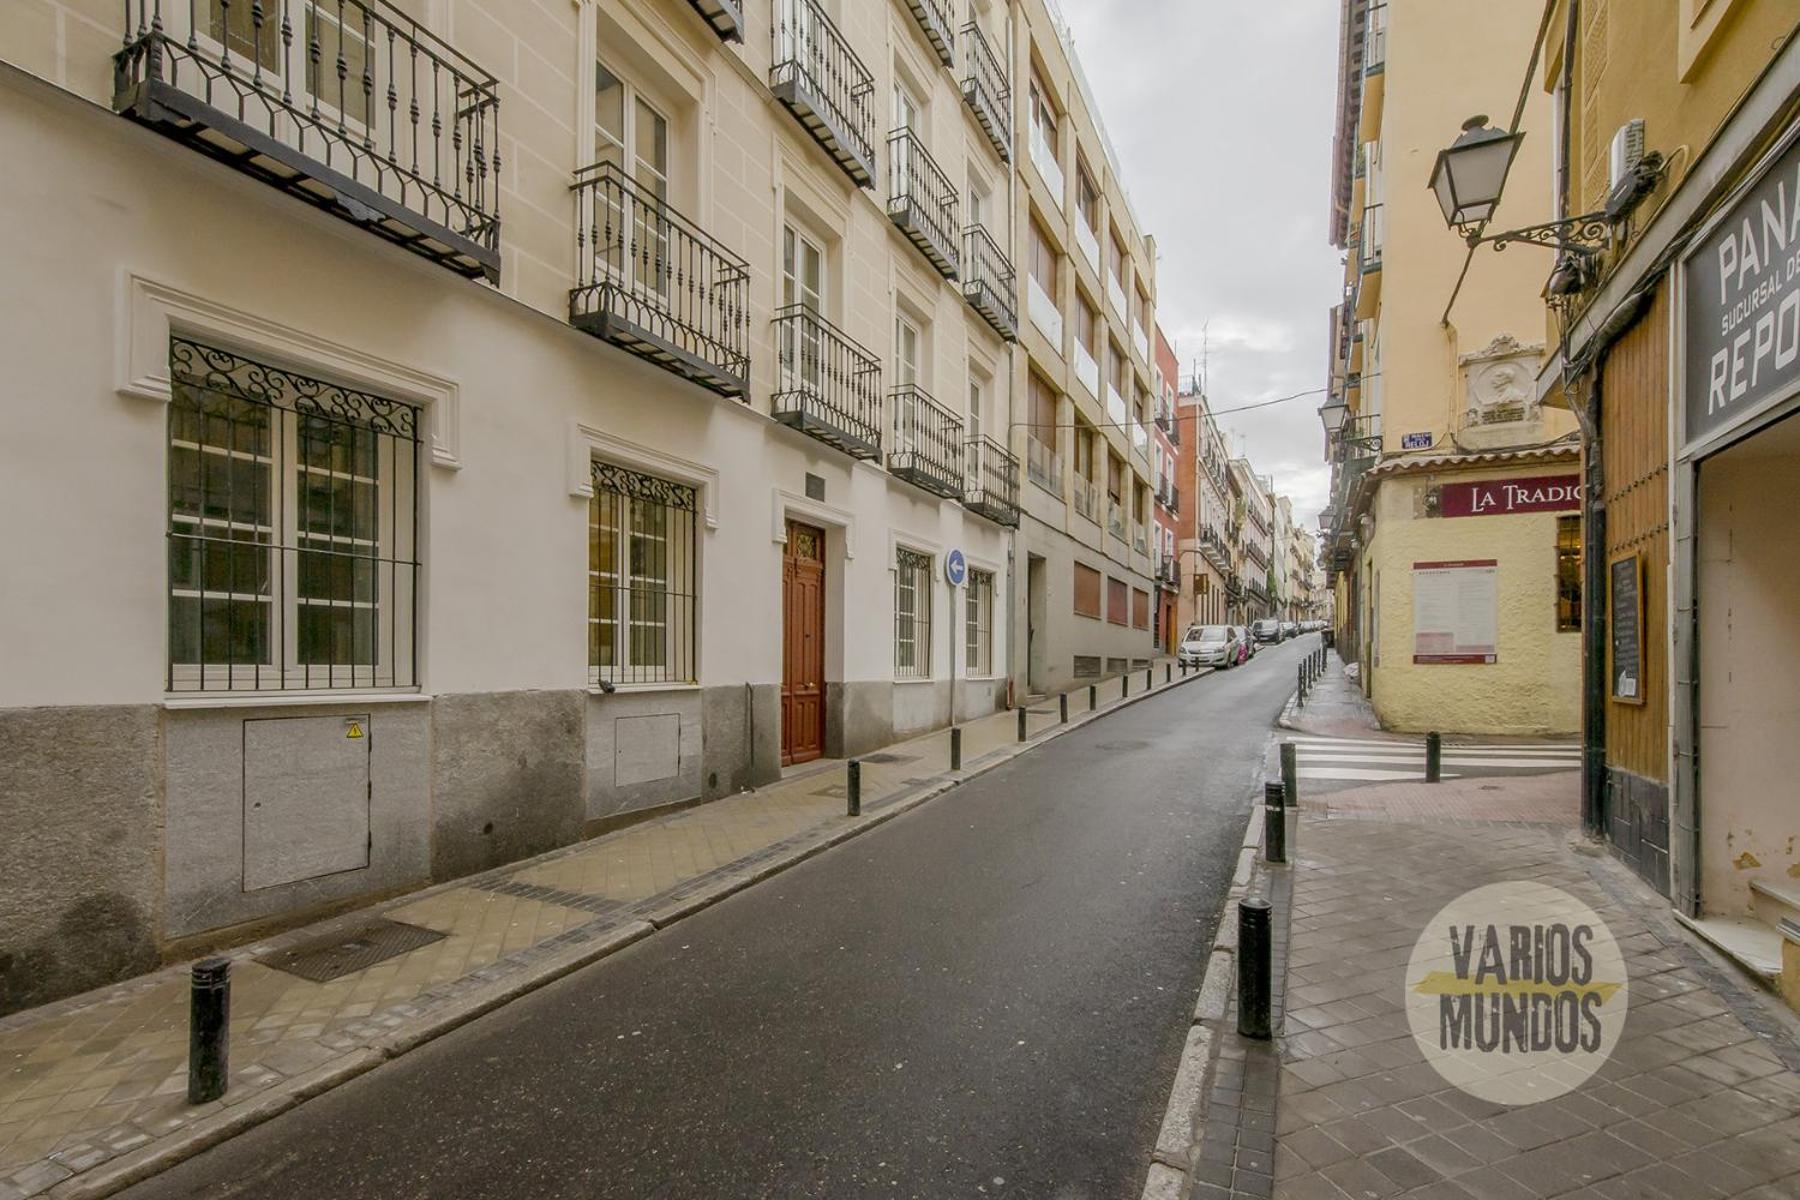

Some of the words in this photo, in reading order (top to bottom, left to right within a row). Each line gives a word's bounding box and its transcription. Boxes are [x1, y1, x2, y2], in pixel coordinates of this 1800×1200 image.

[1721, 270, 1782, 337] SUCURSAL
[1708, 287, 1800, 416] REPO
[1471, 487, 1496, 513] LA
